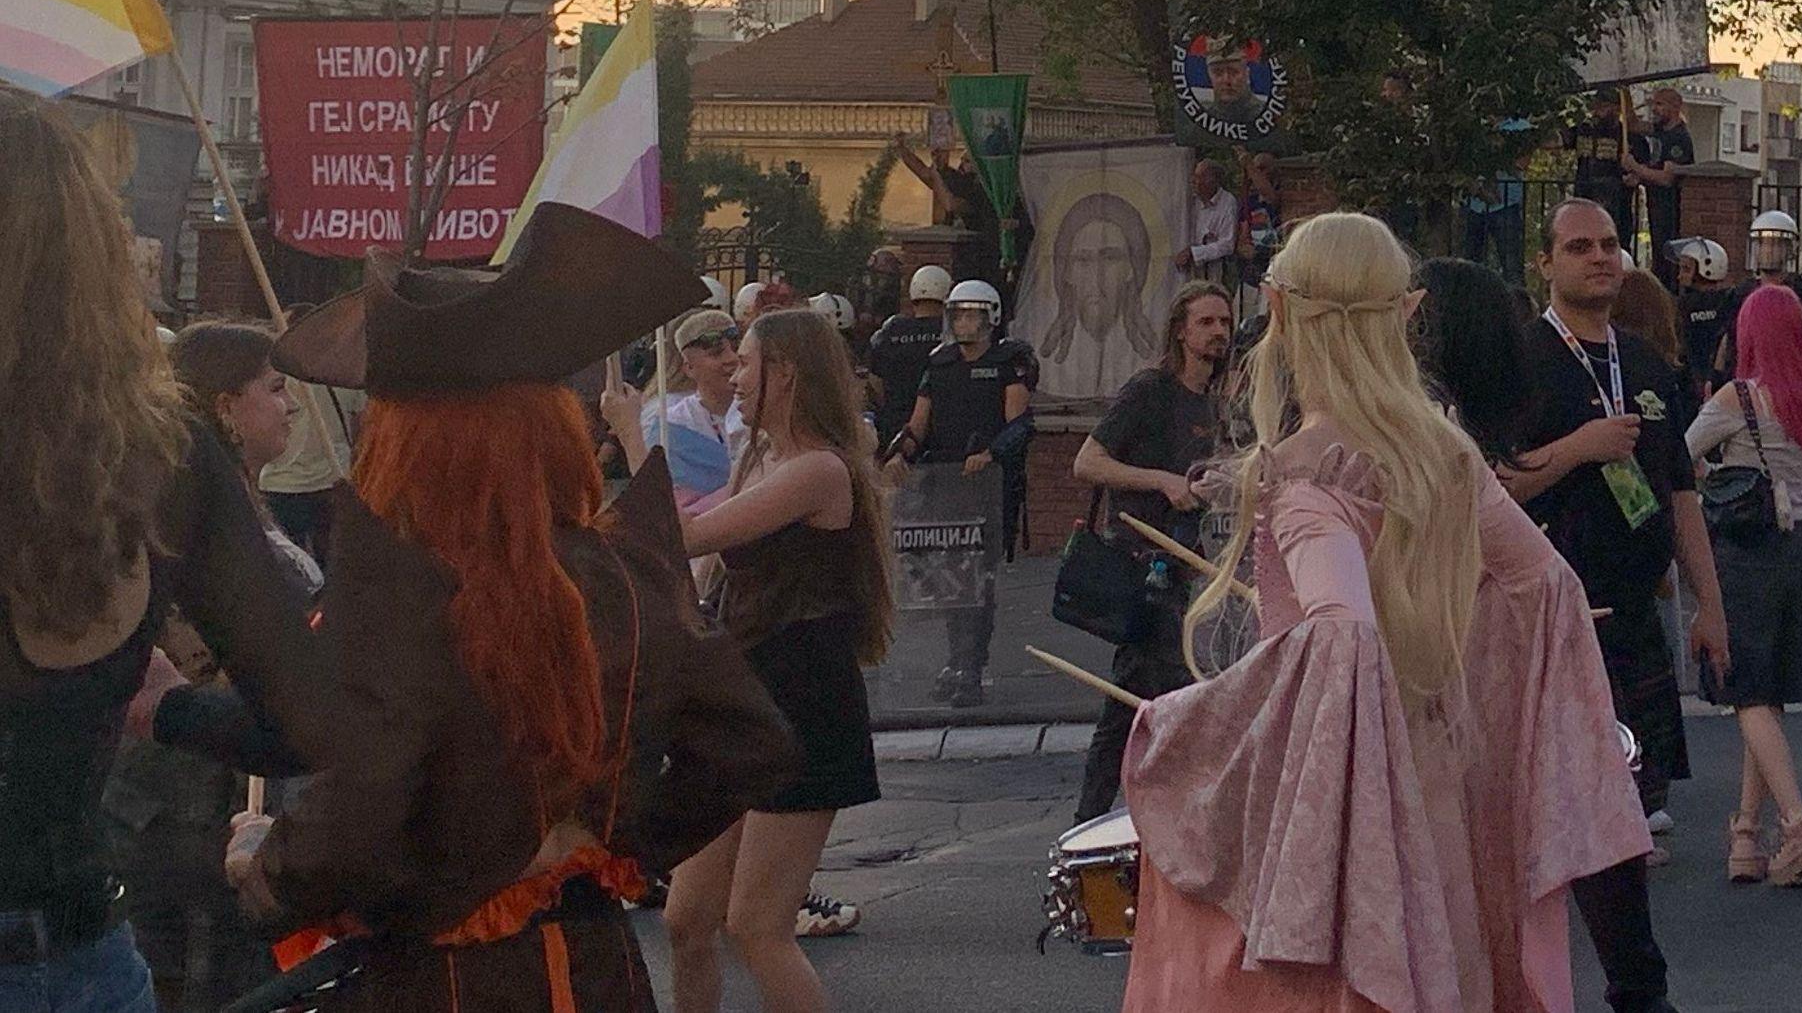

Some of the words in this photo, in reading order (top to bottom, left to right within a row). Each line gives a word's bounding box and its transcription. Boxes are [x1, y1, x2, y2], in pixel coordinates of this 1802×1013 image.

[1172, 44, 1248, 140] РЕПУБЛИКЕ
[1255, 56, 1288, 134] СРПСКЕ
[308, 101, 352, 133] ГЕЈ
[311, 154, 396, 192] НИКАД
[893, 526, 983, 549] ПОЛИЦИЈА
